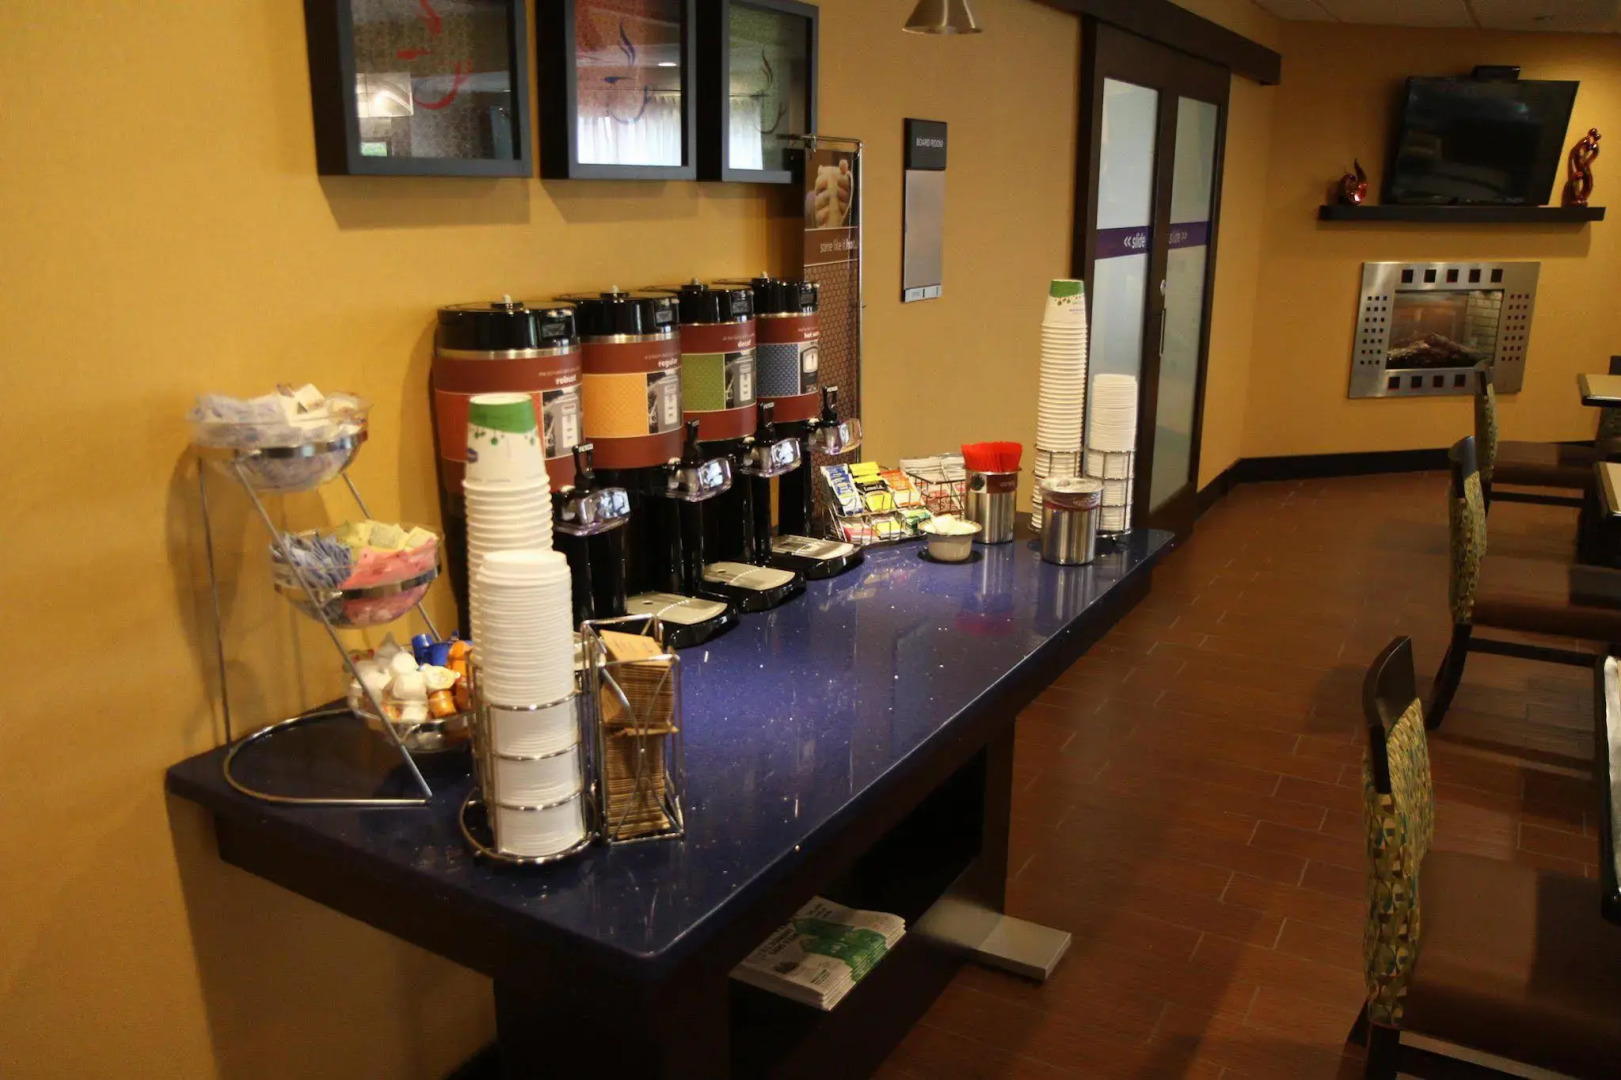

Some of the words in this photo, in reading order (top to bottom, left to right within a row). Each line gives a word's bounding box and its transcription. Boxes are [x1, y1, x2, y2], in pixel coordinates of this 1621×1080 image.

[916, 137, 930, 147] BOARD
[931, 138, 943, 148] ROOM
[820, 242, 833, 253] some
[555, 374, 576, 385] robust
